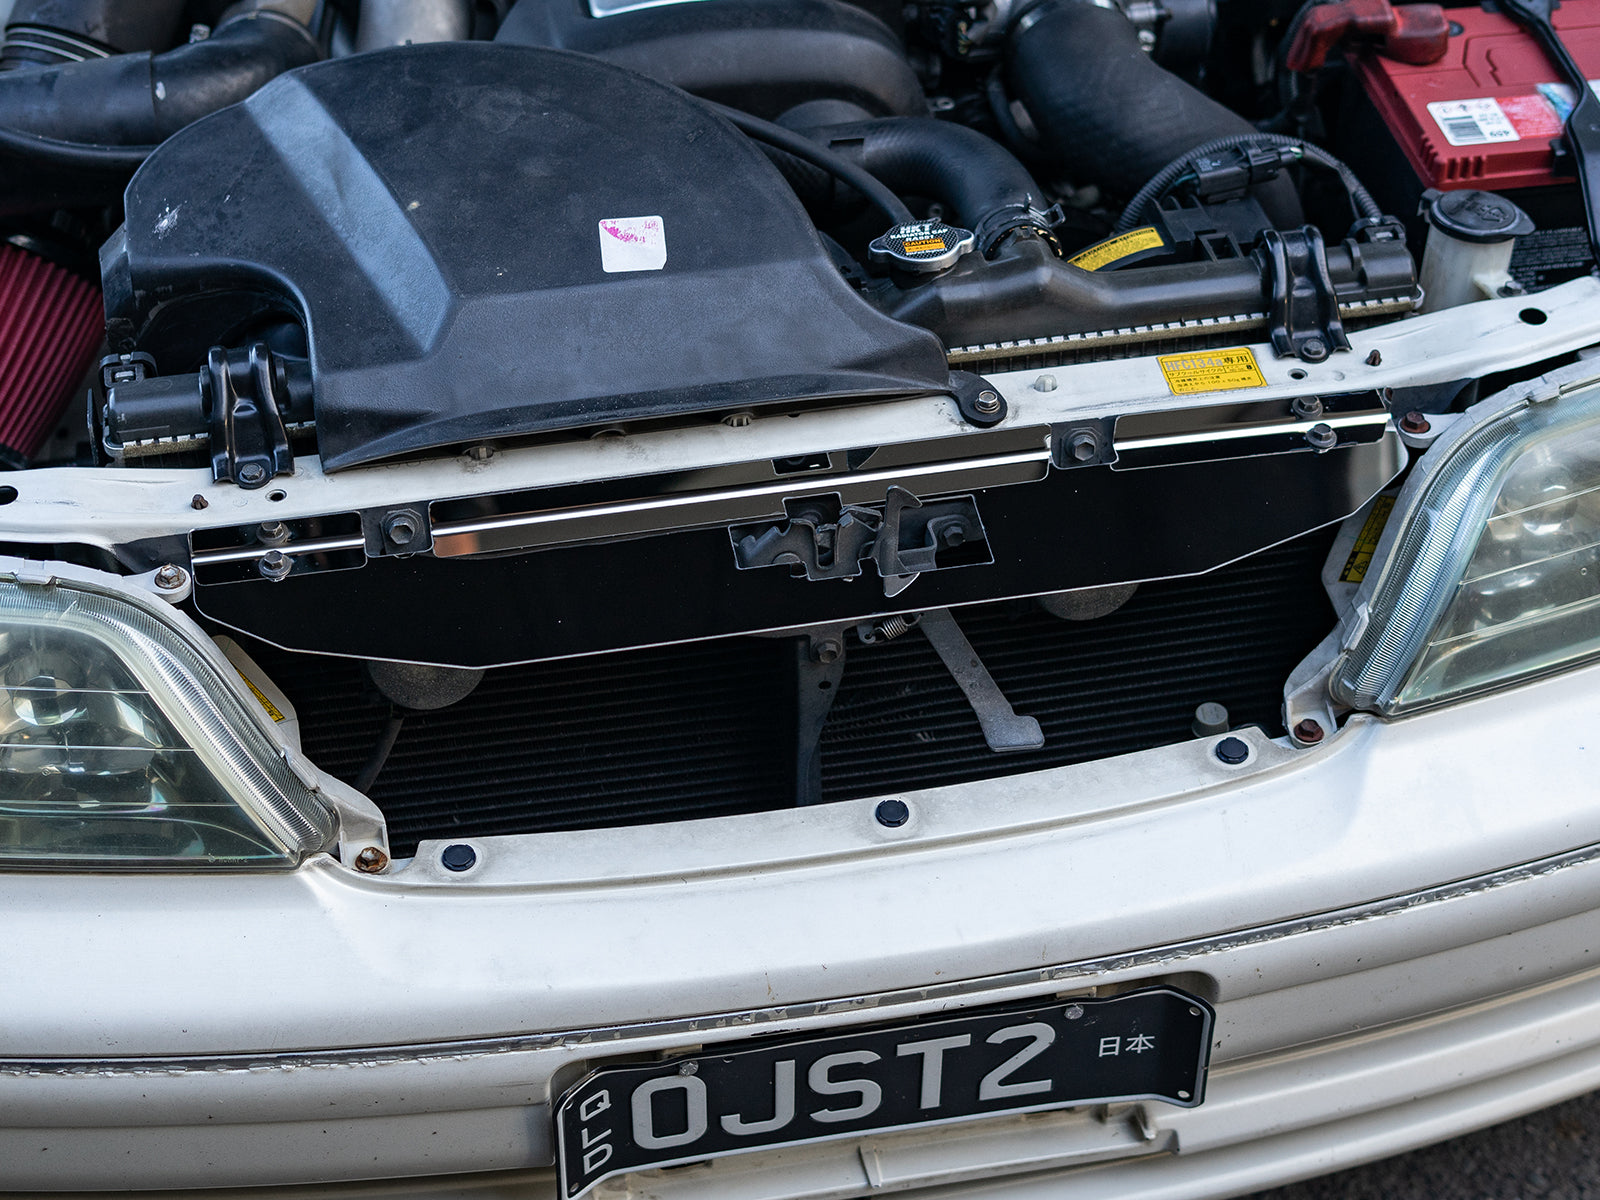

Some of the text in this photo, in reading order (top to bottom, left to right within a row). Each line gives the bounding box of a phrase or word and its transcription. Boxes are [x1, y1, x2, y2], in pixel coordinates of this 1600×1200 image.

[900, 223, 932, 234] HKT
[890, 231, 931, 239] RADIATOR
[905, 238, 941, 246] CAUTION
[1165, 357, 1223, 371] HFC134a
[1098, 1033, 1156, 1058] 日本
[579, 1089, 612, 1175] QLD
